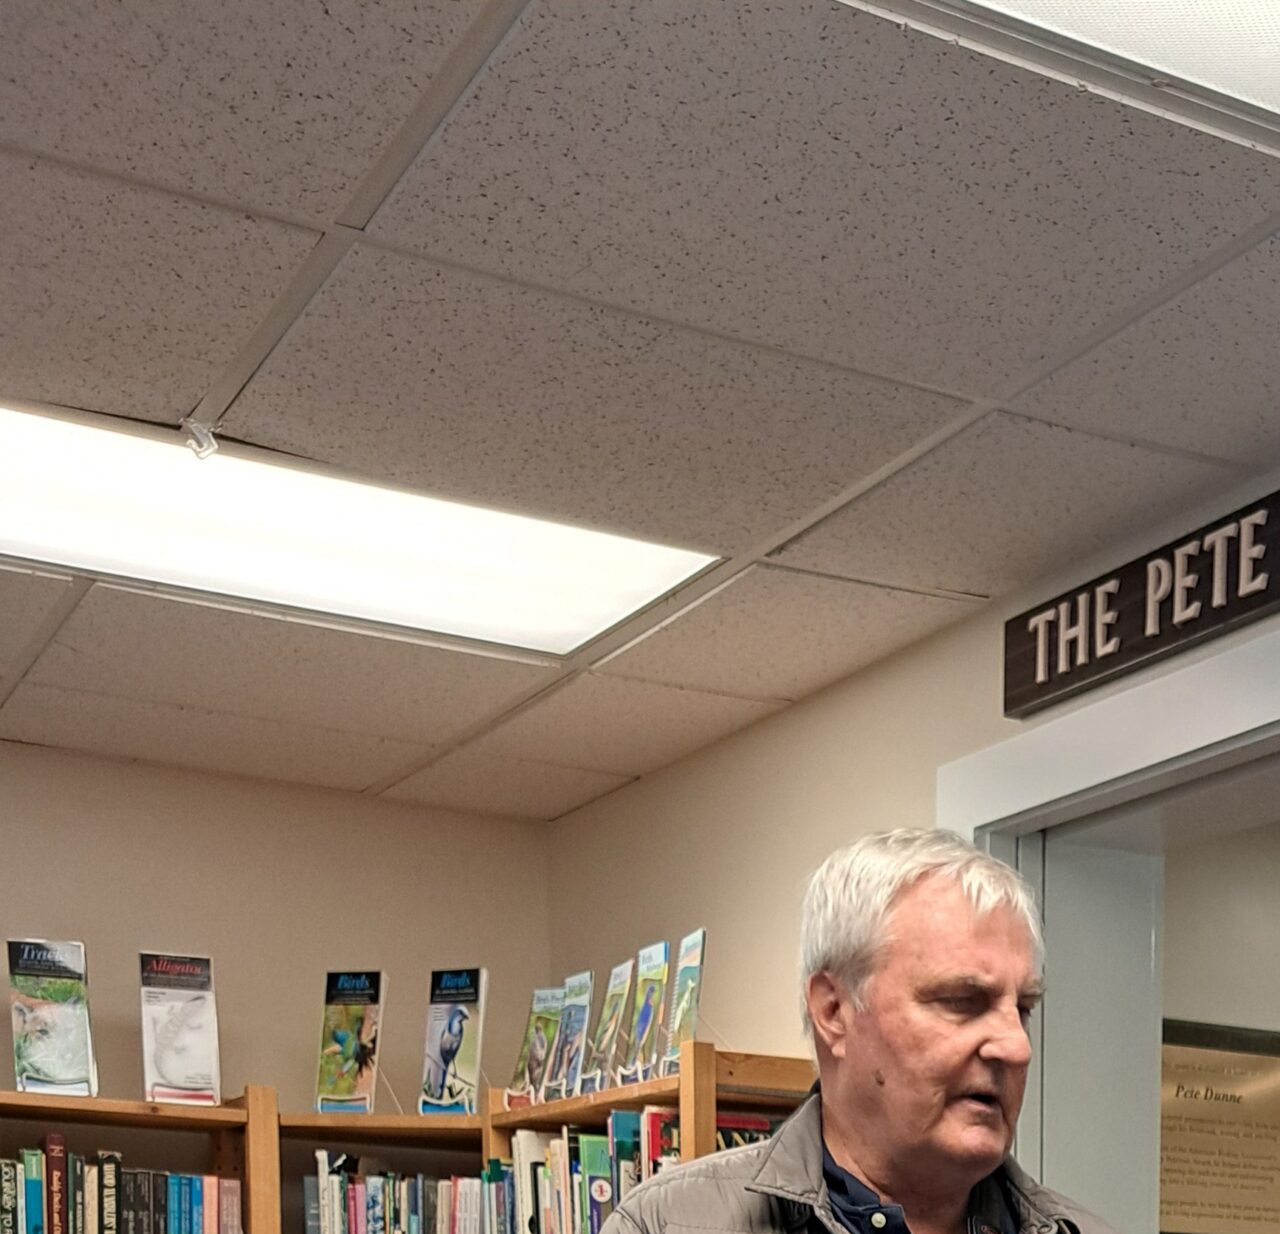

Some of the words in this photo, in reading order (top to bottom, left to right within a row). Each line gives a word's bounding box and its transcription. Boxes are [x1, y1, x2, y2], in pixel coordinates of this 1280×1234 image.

[1027, 579, 1121, 685] THE
[1144, 510, 1269, 637] PETE
[337, 974, 370, 989] Birds
[440, 971, 472, 988] Birds
[1175, 1082, 1201, 1100] Pete
[1203, 1086, 1244, 1105] Dunne
[1, 1163, 17, 1210] JOURNEY
[3, 1212, 14, 1223] TO
